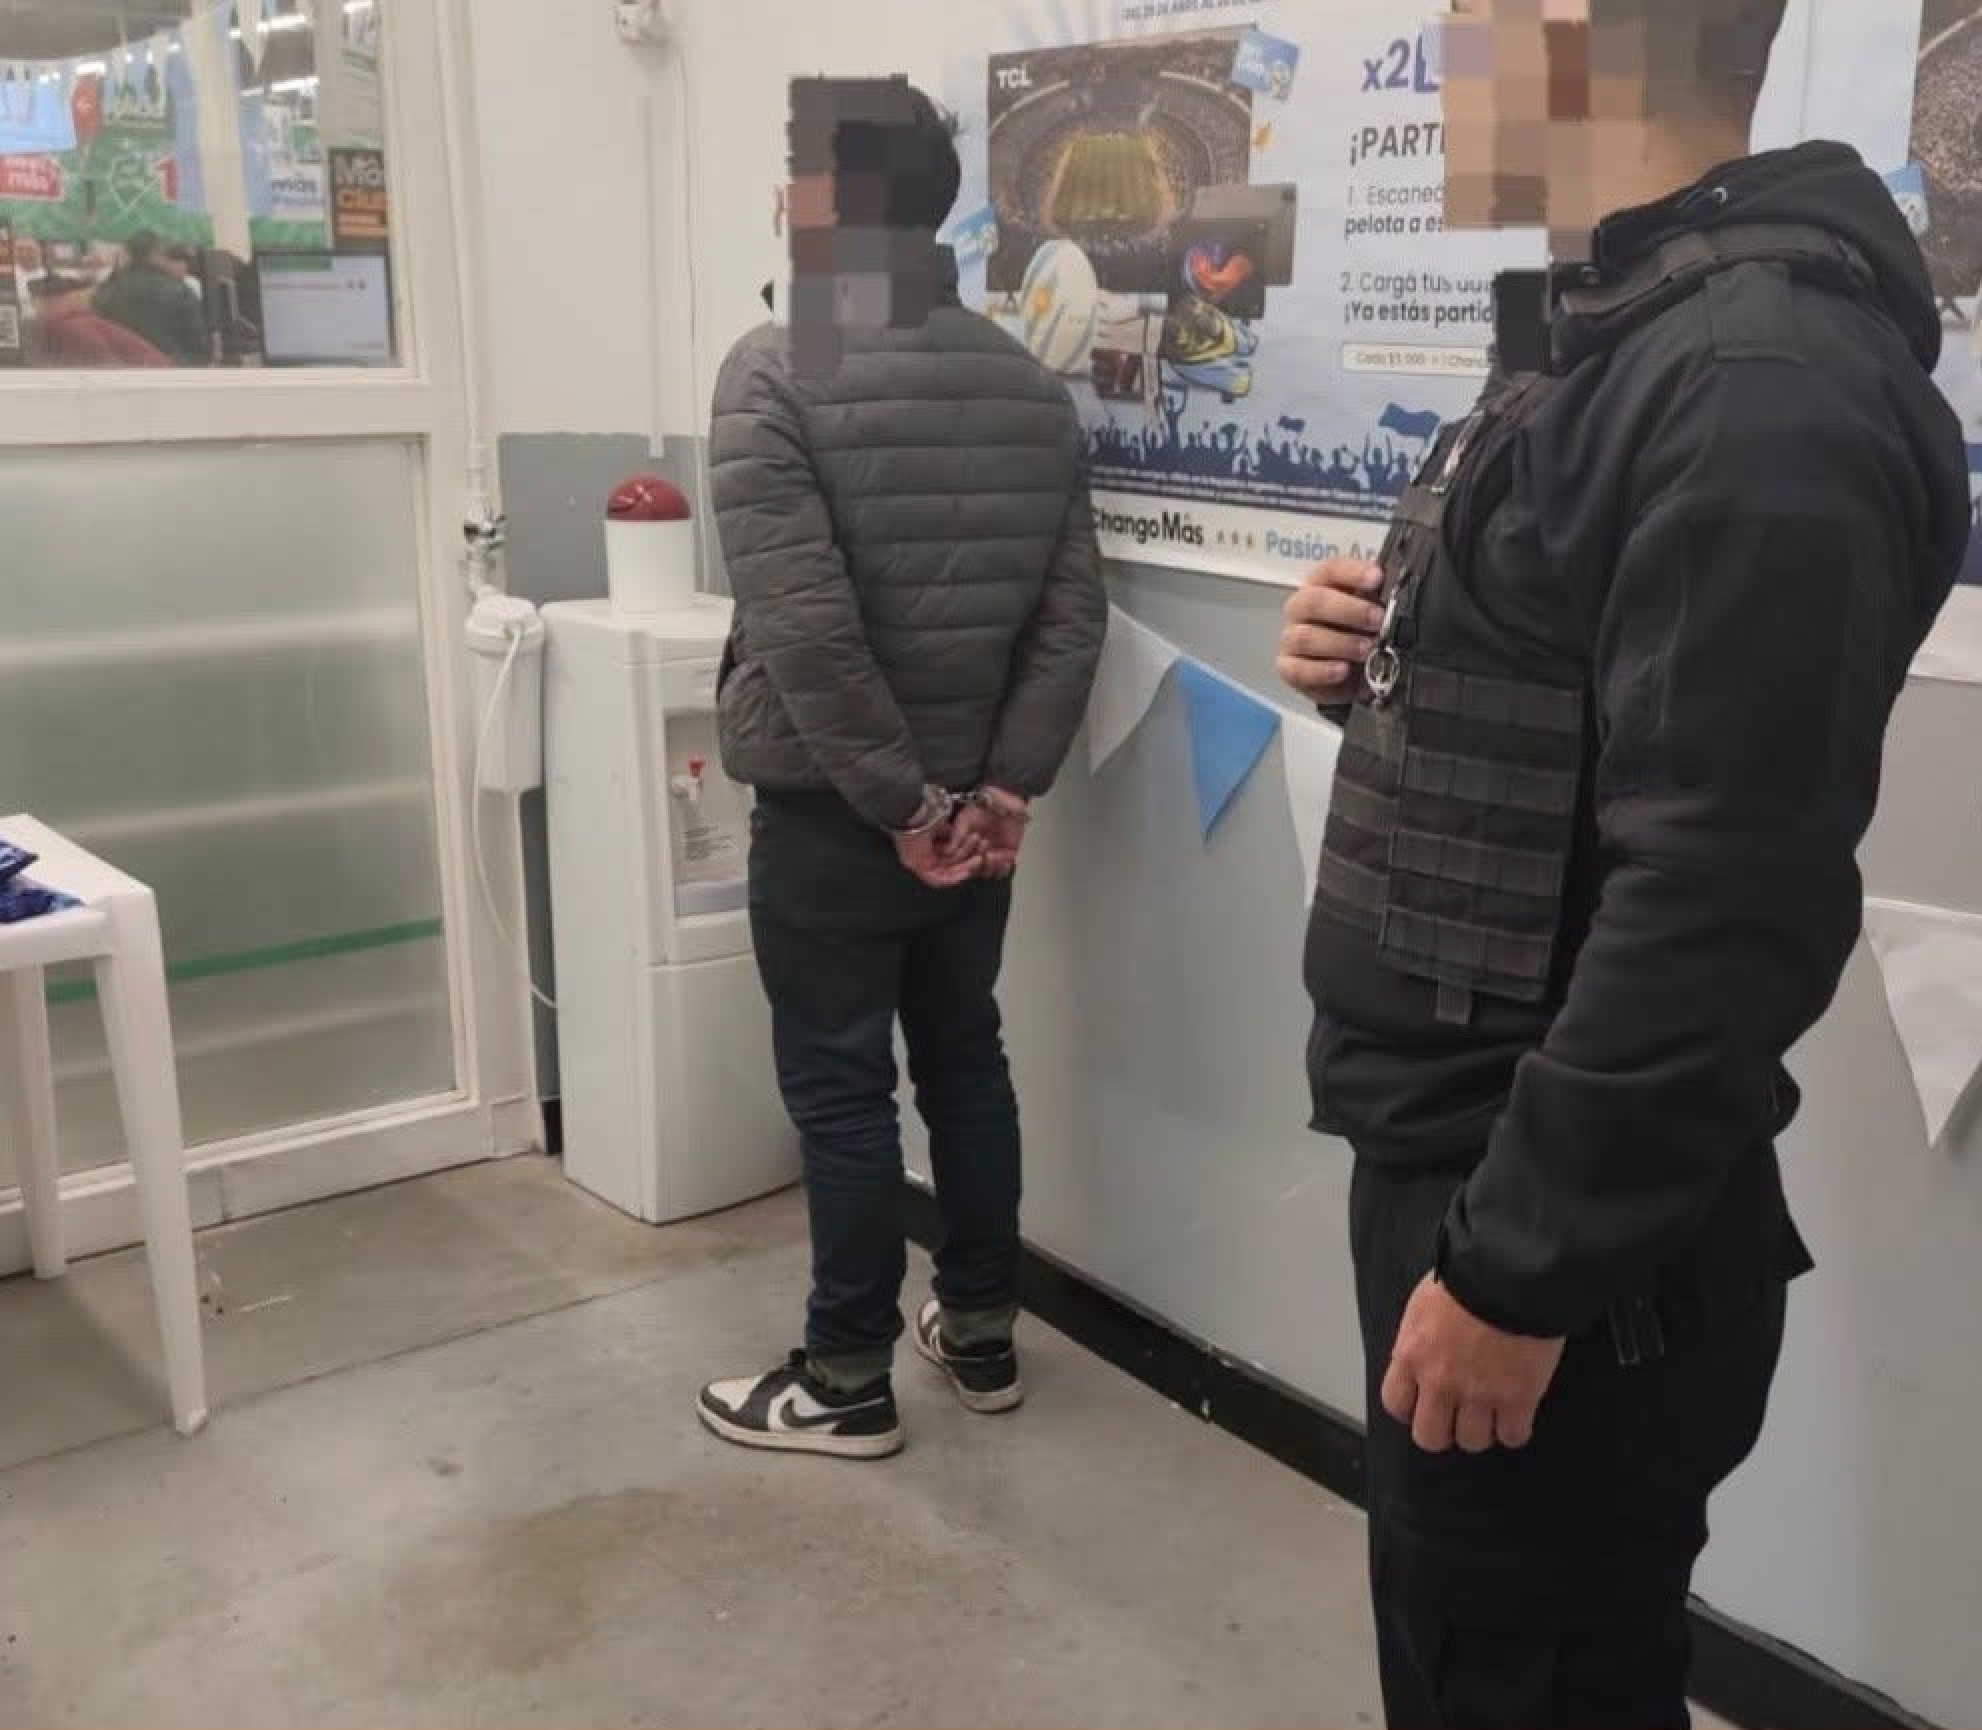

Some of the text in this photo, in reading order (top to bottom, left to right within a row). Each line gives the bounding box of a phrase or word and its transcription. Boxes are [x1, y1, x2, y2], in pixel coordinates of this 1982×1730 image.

[996, 64, 1032, 89] TCL
[1344, 214, 1404, 241] pelota
[1409, 216, 1421, 234] a
[1359, 270, 1417, 299] Cargá
[1344, 302, 1374, 325] ¡Ya
[1378, 300, 1430, 322] estás
[1265, 529, 1339, 561] Pasión
